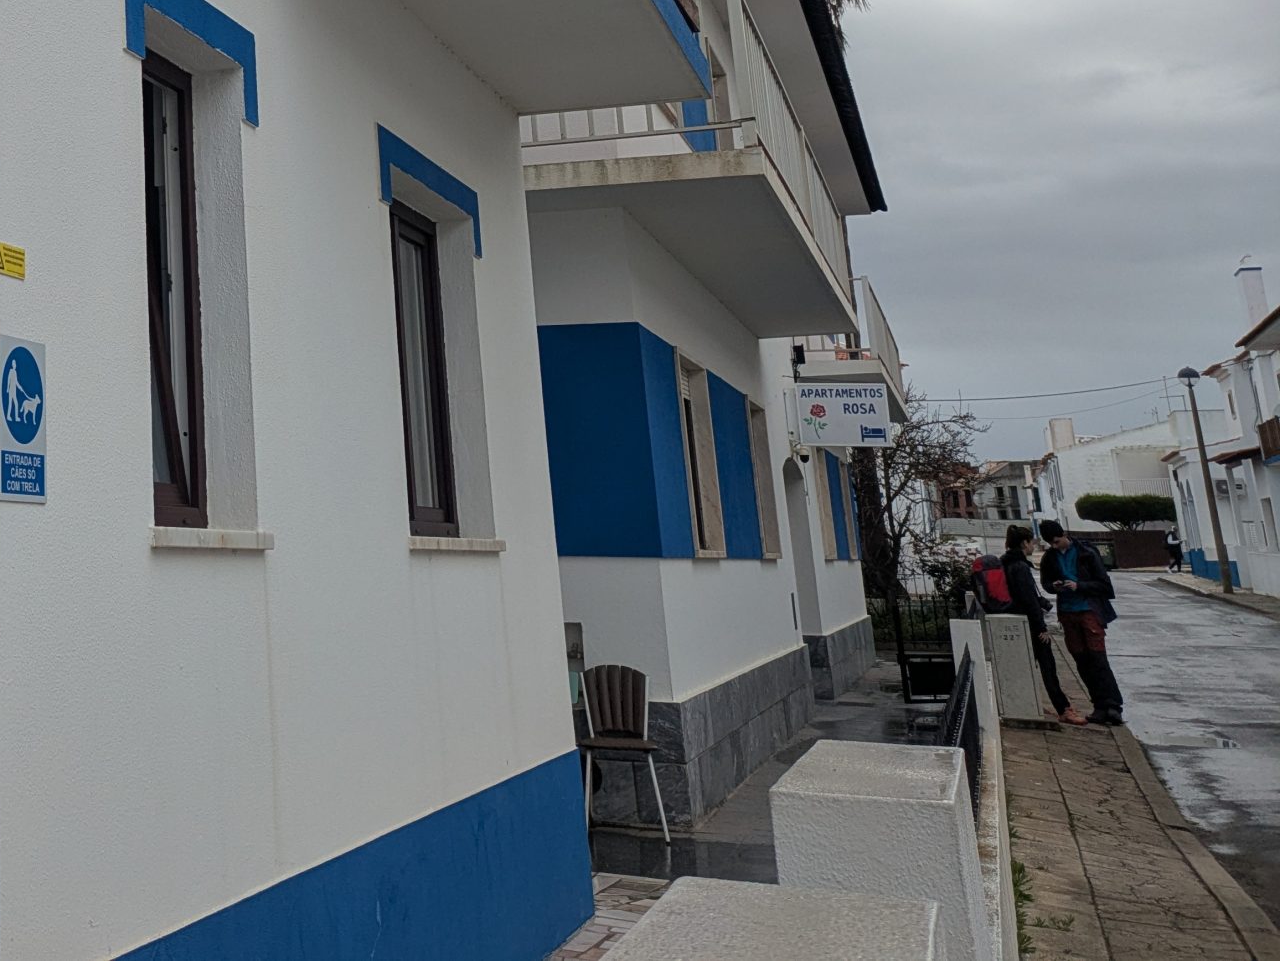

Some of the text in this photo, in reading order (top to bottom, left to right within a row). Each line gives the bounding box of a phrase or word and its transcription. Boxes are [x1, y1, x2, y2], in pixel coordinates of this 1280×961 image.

[800, 388, 883, 398] APARTAMENTOS
[843, 403, 876, 414] ROSA
[4, 454, 41, 467] ENTRADA DE
[10, 466, 26, 478] CÃES
[6, 480, 40, 493] COM TRELA
